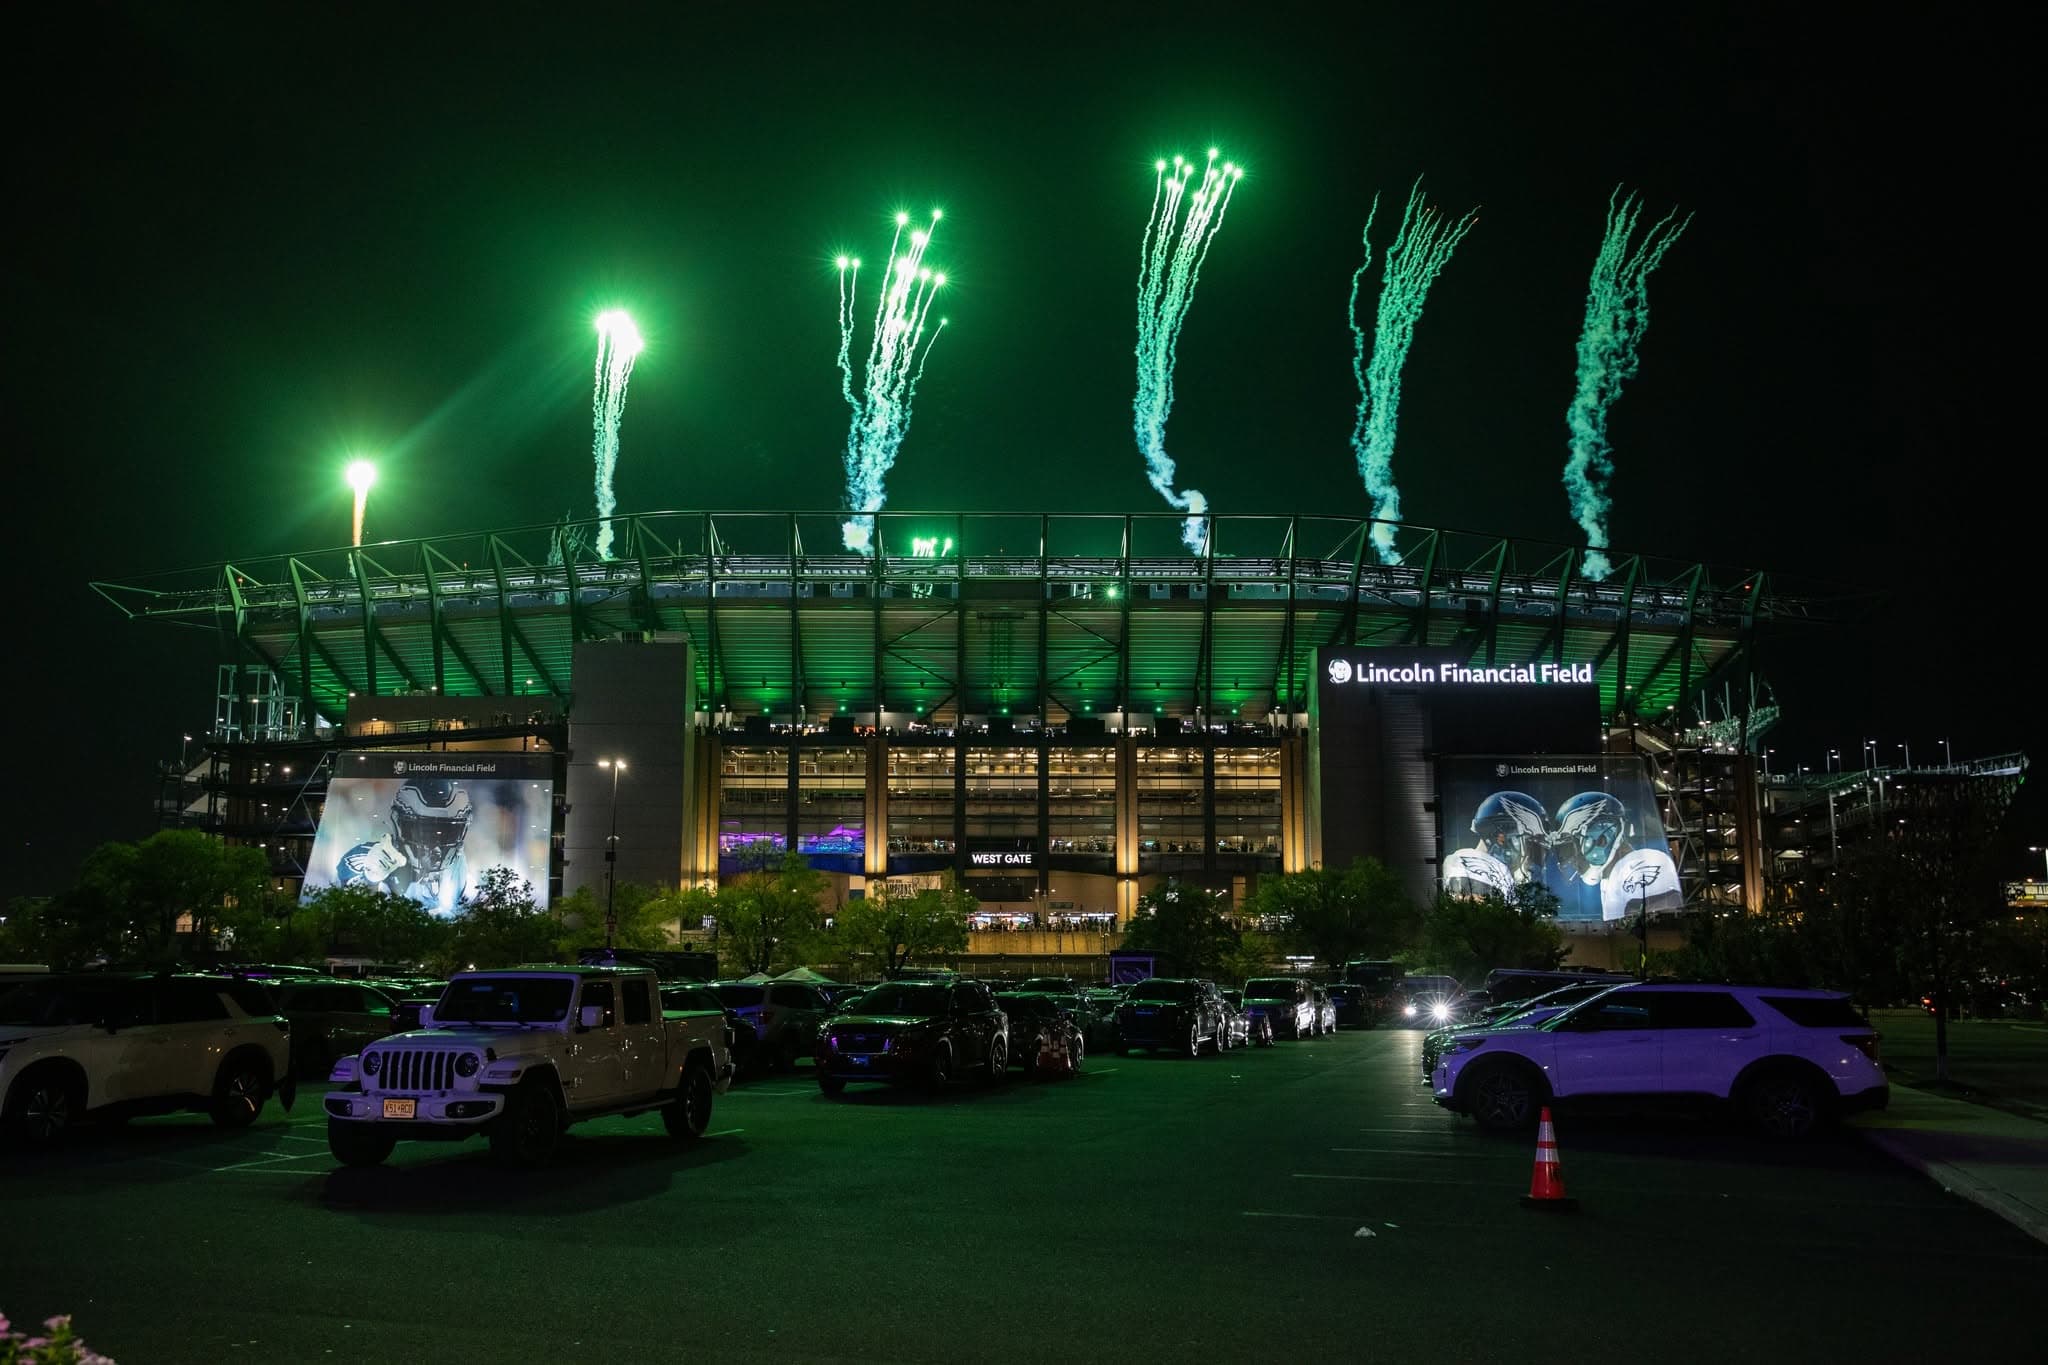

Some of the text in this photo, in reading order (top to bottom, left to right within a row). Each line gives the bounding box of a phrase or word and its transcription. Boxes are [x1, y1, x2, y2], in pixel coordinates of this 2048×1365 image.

[1357, 663, 1592, 683] Lincoln Financial Field
[408, 761, 496, 773] Lincoln Financial Field
[1510, 764, 1597, 774] Lincoln Financial Field
[971, 854, 1032, 864] WEST GATE
